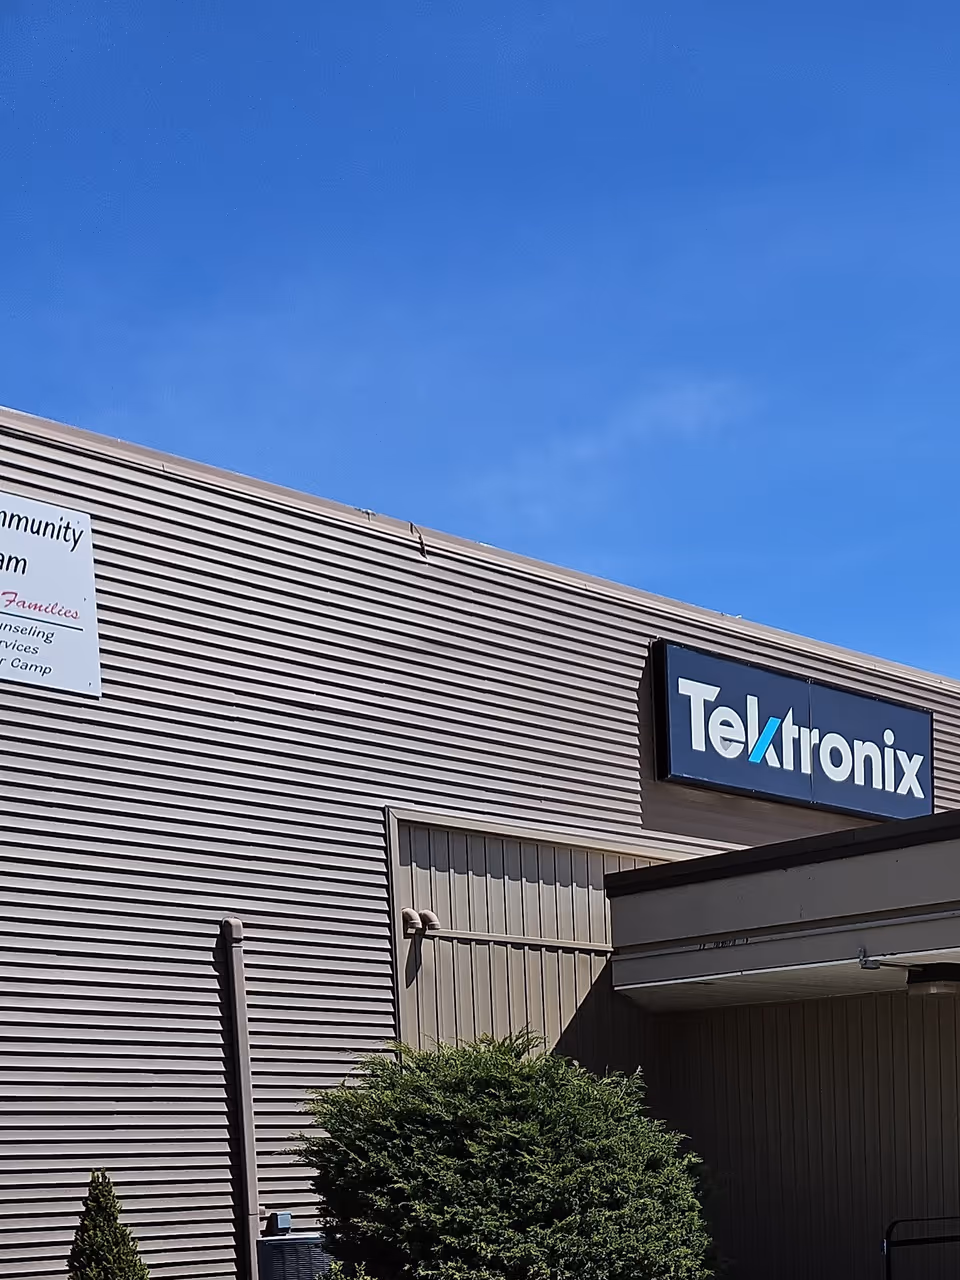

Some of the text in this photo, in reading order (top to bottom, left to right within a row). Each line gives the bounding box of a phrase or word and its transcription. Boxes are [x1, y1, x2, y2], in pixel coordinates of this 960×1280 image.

[1, 591, 80, 619] Families
[10, 657, 52, 677] Camp
[678, 677, 925, 799] Tektronix
